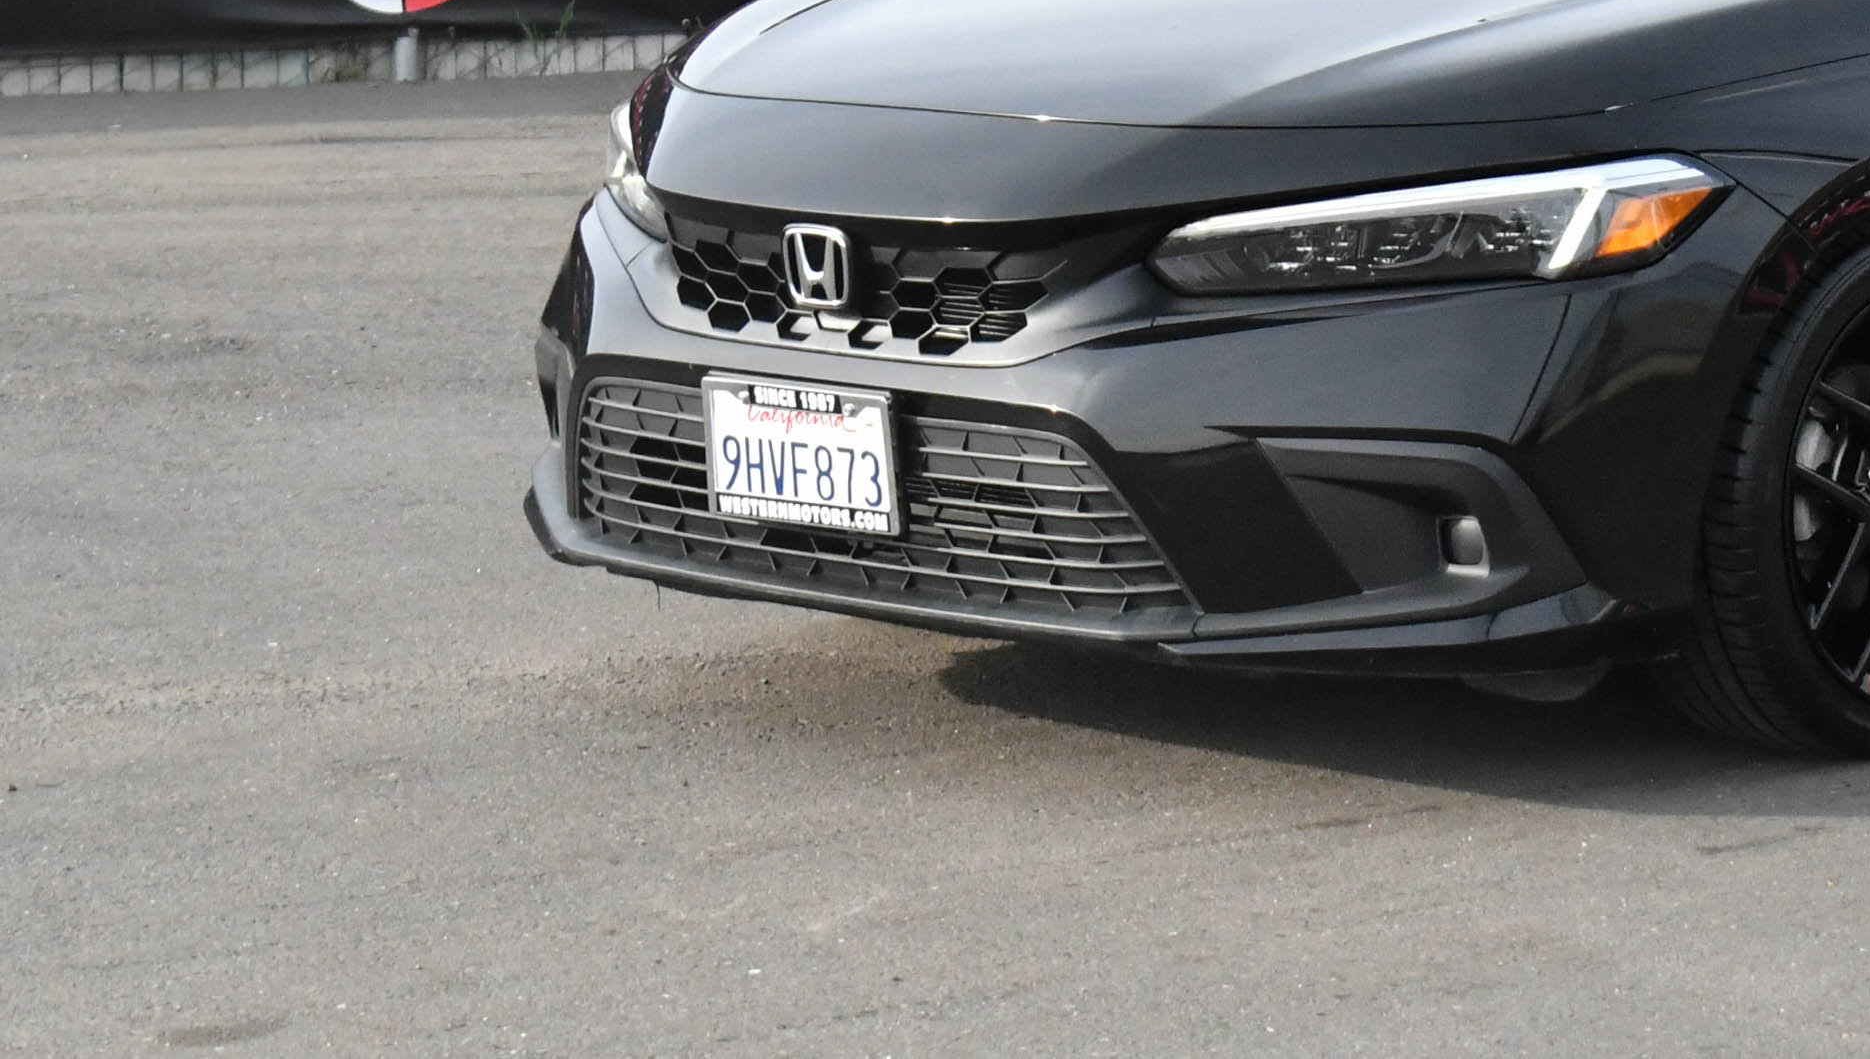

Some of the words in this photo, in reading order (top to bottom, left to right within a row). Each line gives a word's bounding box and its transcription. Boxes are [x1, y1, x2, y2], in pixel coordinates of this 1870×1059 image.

[753, 386, 797, 408] SINCE
[722, 435, 882, 507] 9HVF873
[718, 495, 889, 532] WESTERNMOTORS.COM
